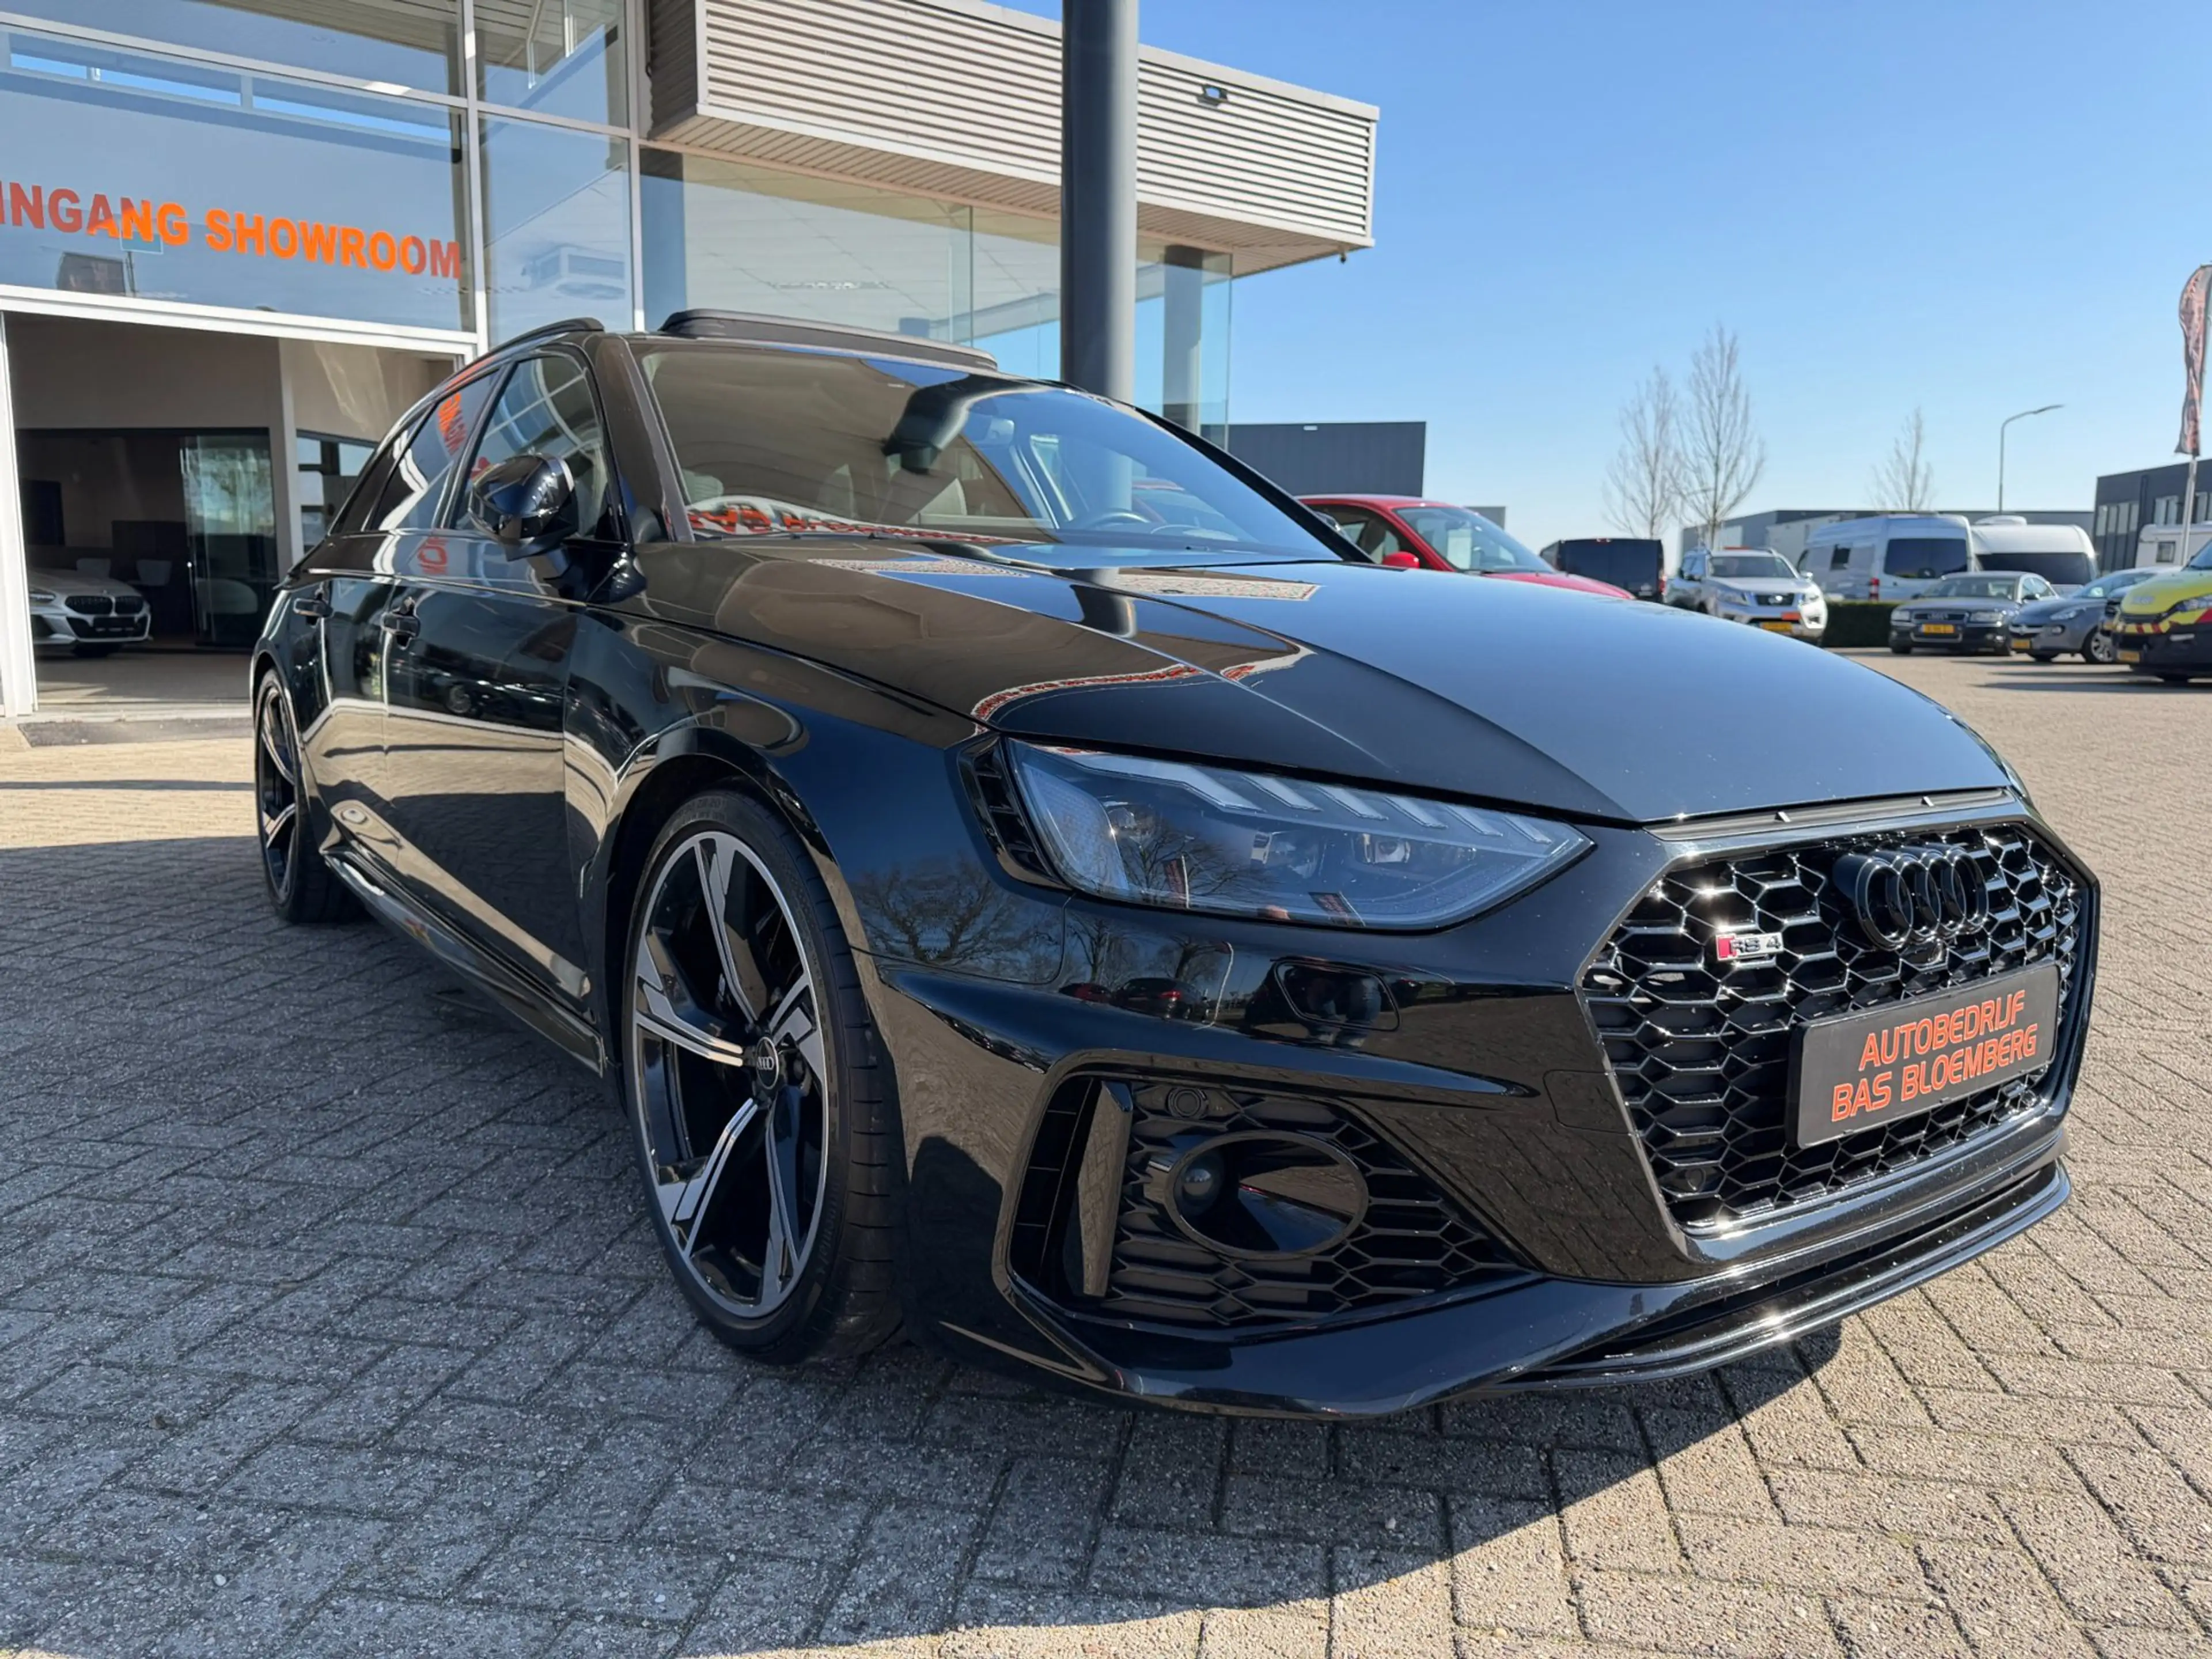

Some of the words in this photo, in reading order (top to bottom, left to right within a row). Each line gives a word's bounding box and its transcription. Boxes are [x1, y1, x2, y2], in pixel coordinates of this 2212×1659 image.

[204, 208, 460, 279] SHOWROOM
[1858, 990, 2025, 1071] AUTOBEDRIJF
[1831, 1071, 1892, 1122] BAS
[1900, 1023, 2038, 1102] BLOEMBERG
